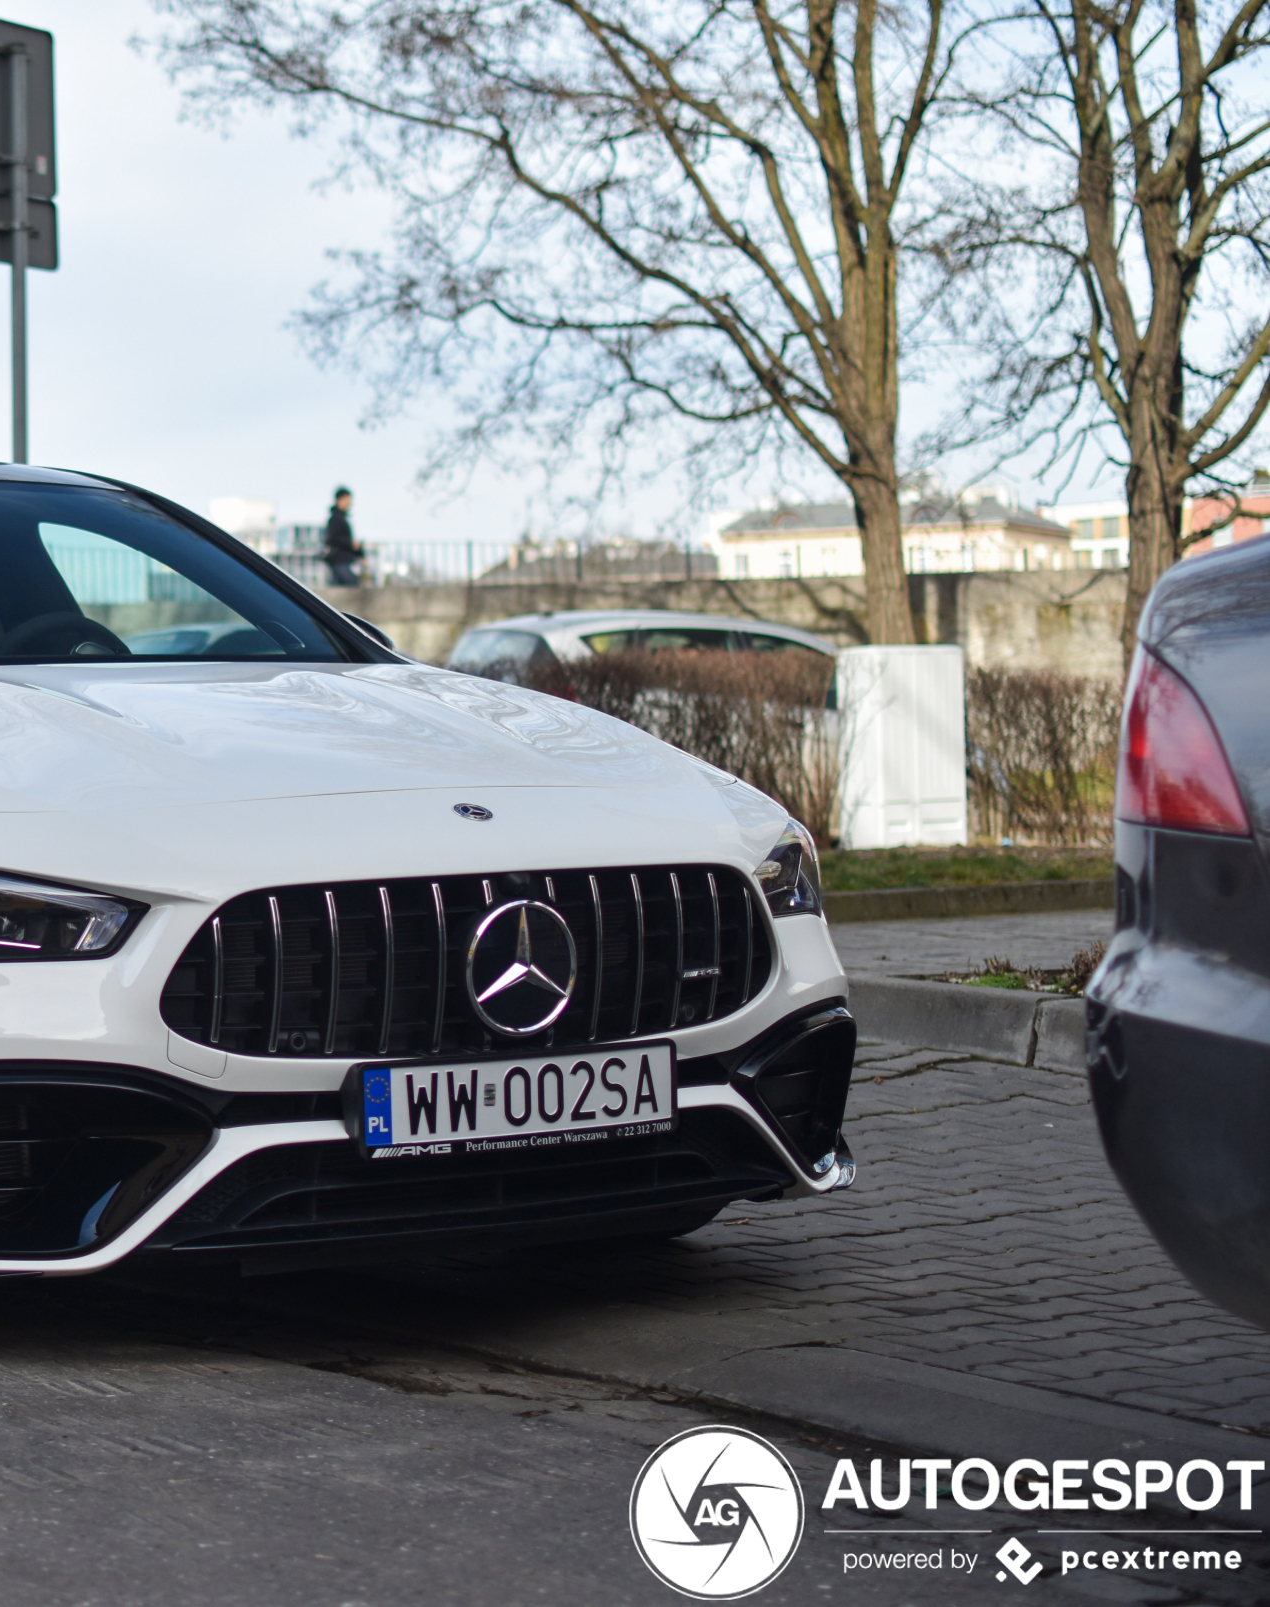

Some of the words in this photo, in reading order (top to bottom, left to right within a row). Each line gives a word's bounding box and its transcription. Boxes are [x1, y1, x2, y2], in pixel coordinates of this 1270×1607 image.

[405, 1069, 478, 1135] WW
[503, 1053, 659, 1127] 002SA
[368, 1116, 389, 1133] PL
[624, 1126, 635, 1136] 22
[636, 1124, 650, 1135] 312
[652, 1121, 671, 1133] 7000
[397, 1143, 452, 1157] AMG
[465, 1138, 528, 1152] Performance
[530, 1135, 561, 1146] Center
[563, 1131, 608, 1143] Warszawa
